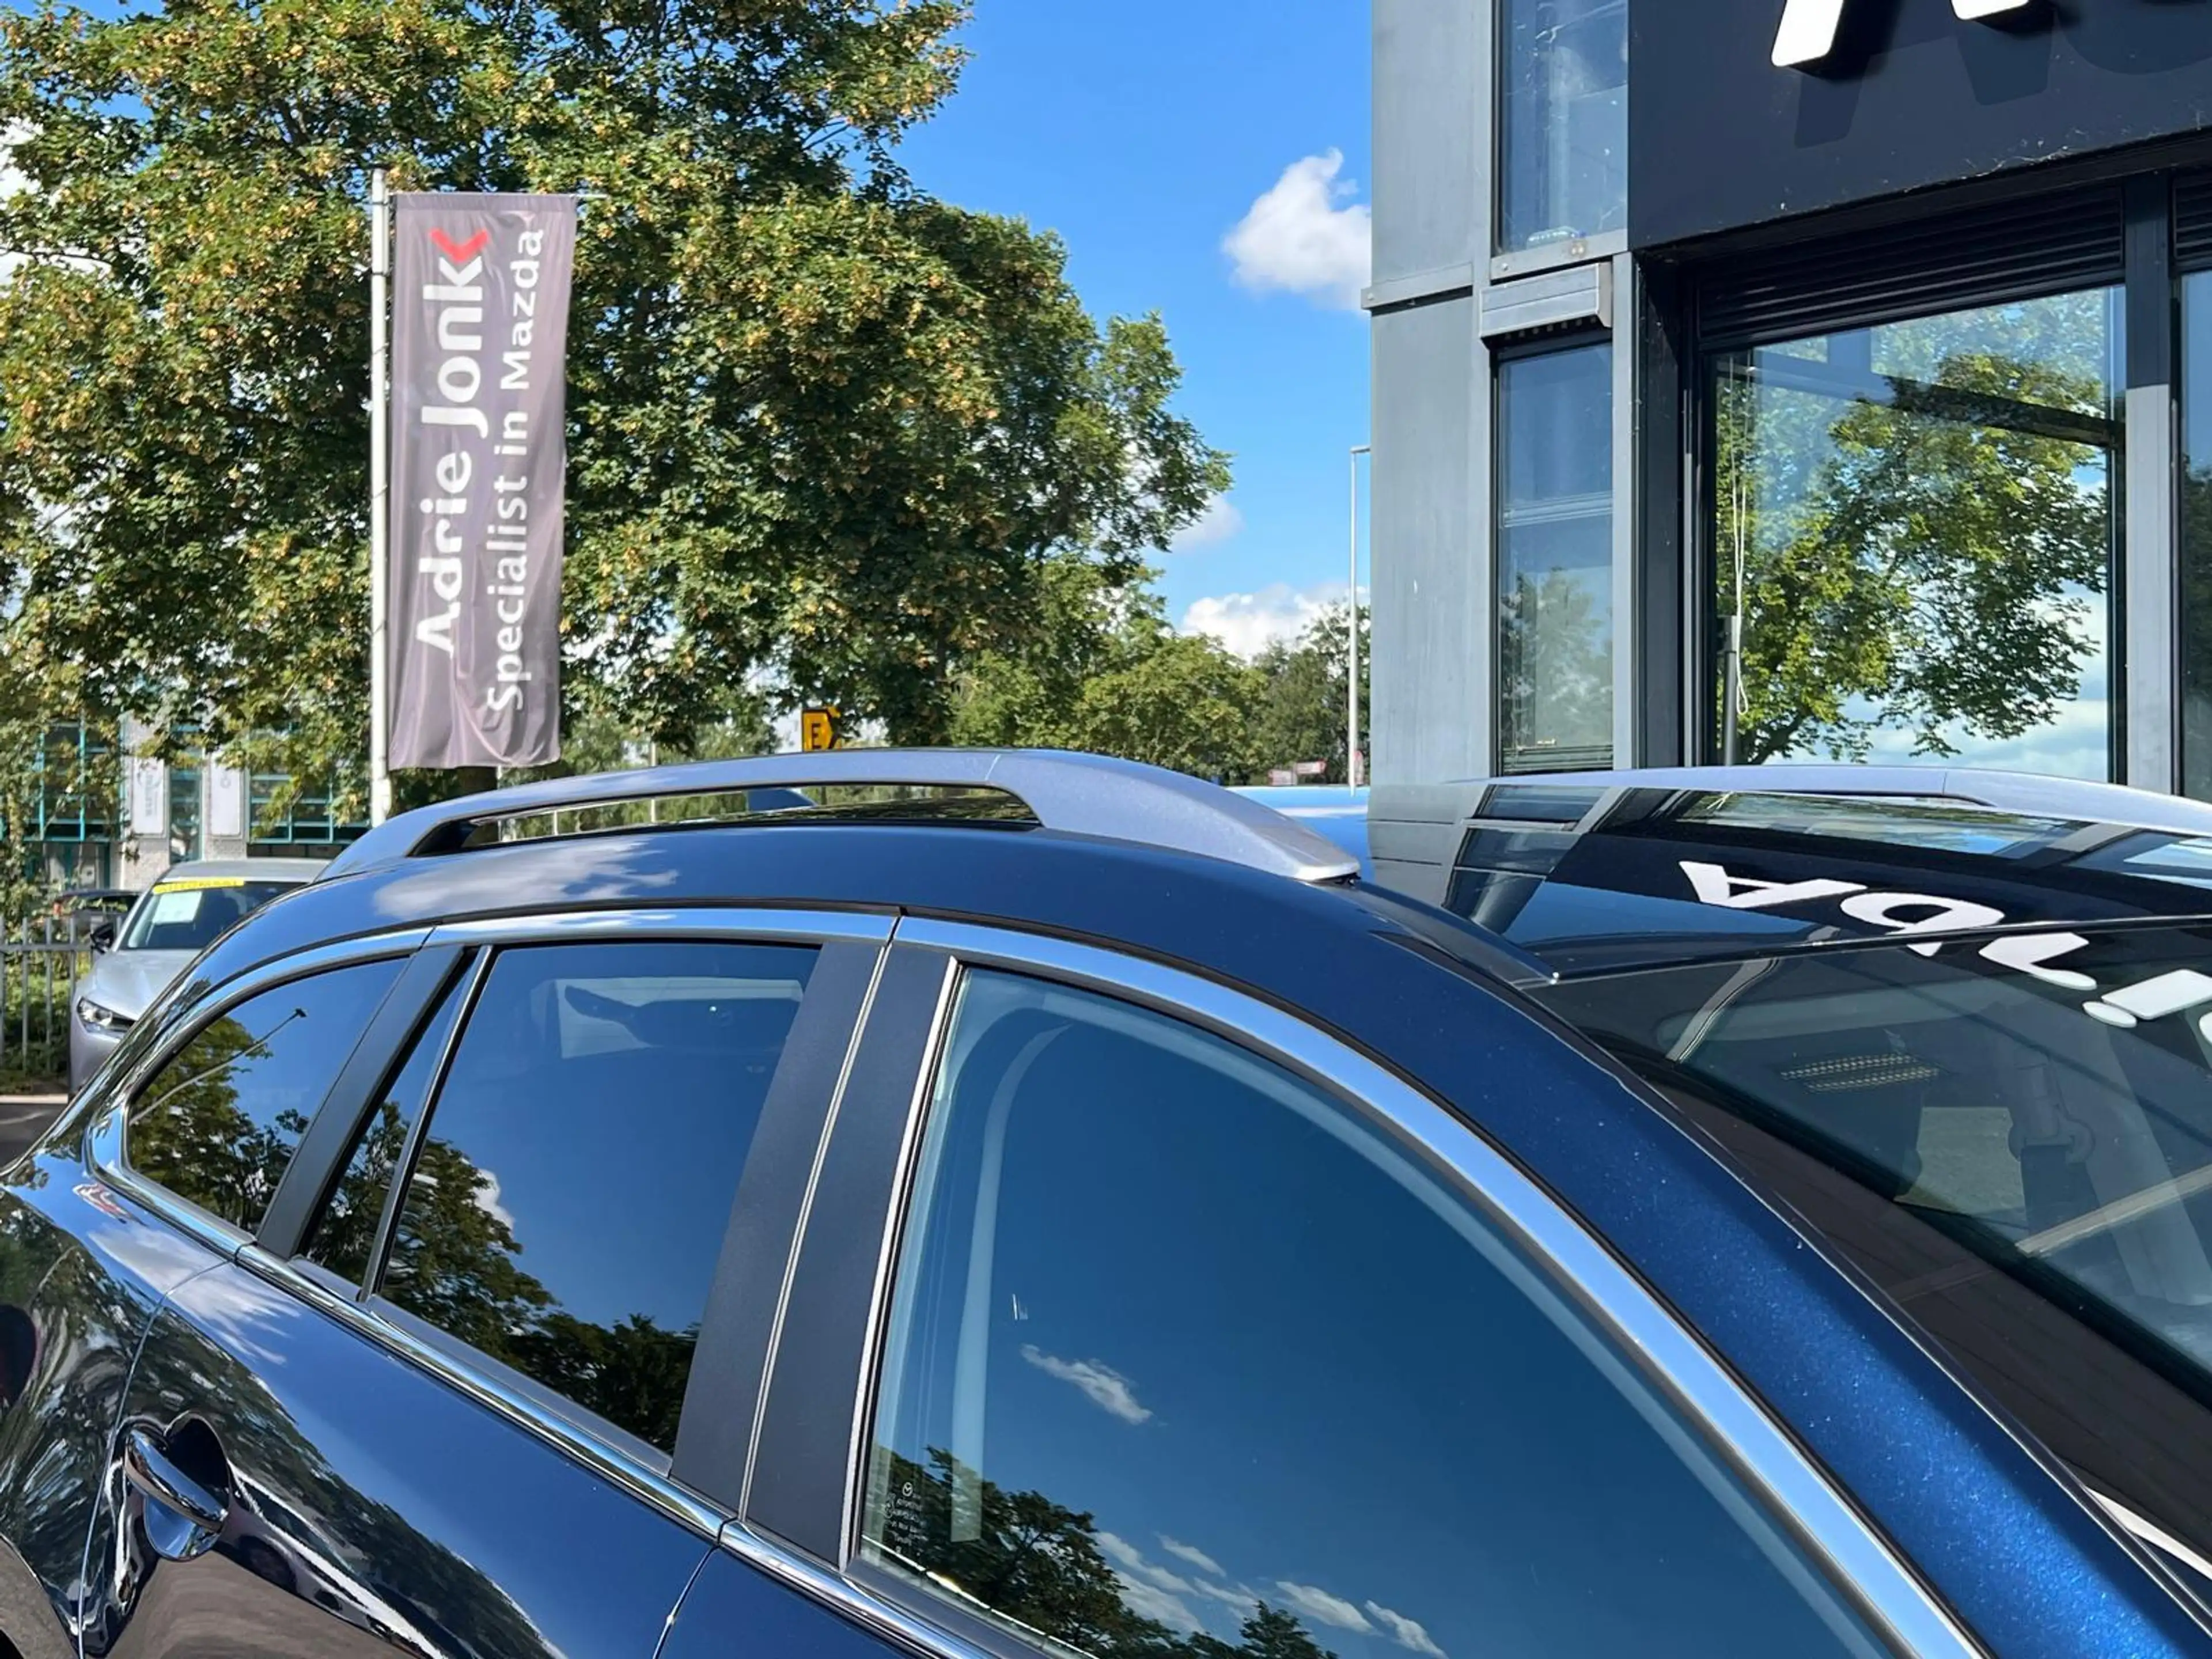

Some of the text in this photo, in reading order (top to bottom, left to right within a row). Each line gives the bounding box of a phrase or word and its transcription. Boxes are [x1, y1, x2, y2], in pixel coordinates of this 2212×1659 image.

[416, 255, 488, 660] Adrie Jonk
[486, 229, 544, 710] Specialist in Mazda
